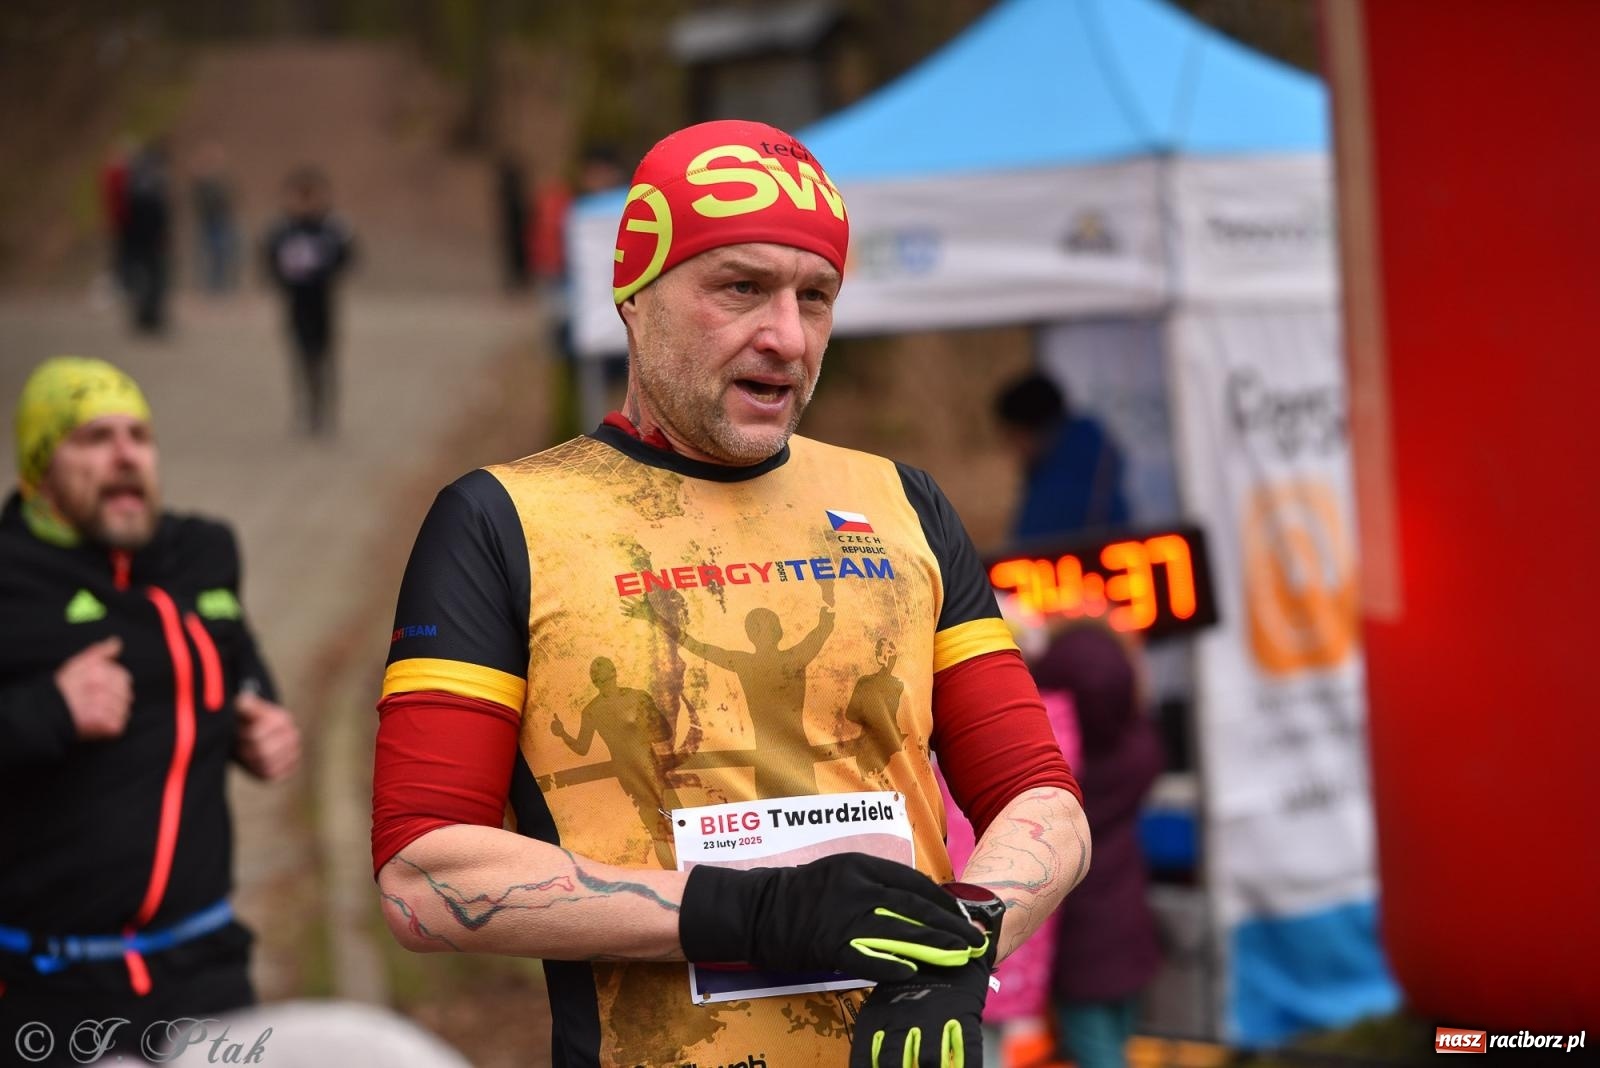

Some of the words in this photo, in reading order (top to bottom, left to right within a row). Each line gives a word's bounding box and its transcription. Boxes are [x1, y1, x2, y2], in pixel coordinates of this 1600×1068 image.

[837, 535, 882, 544] CZECH
[841, 545, 886, 555] REPUBLIC
[614, 562, 773, 597] ENERGY
[784, 557, 895, 581] TEAM
[700, 811, 760, 836] BIEG
[767, 800, 894, 828] Twardziela
[703, 841, 715, 850] 23
[716, 839, 737, 851] luty
[738, 836, 763, 847] 2025
